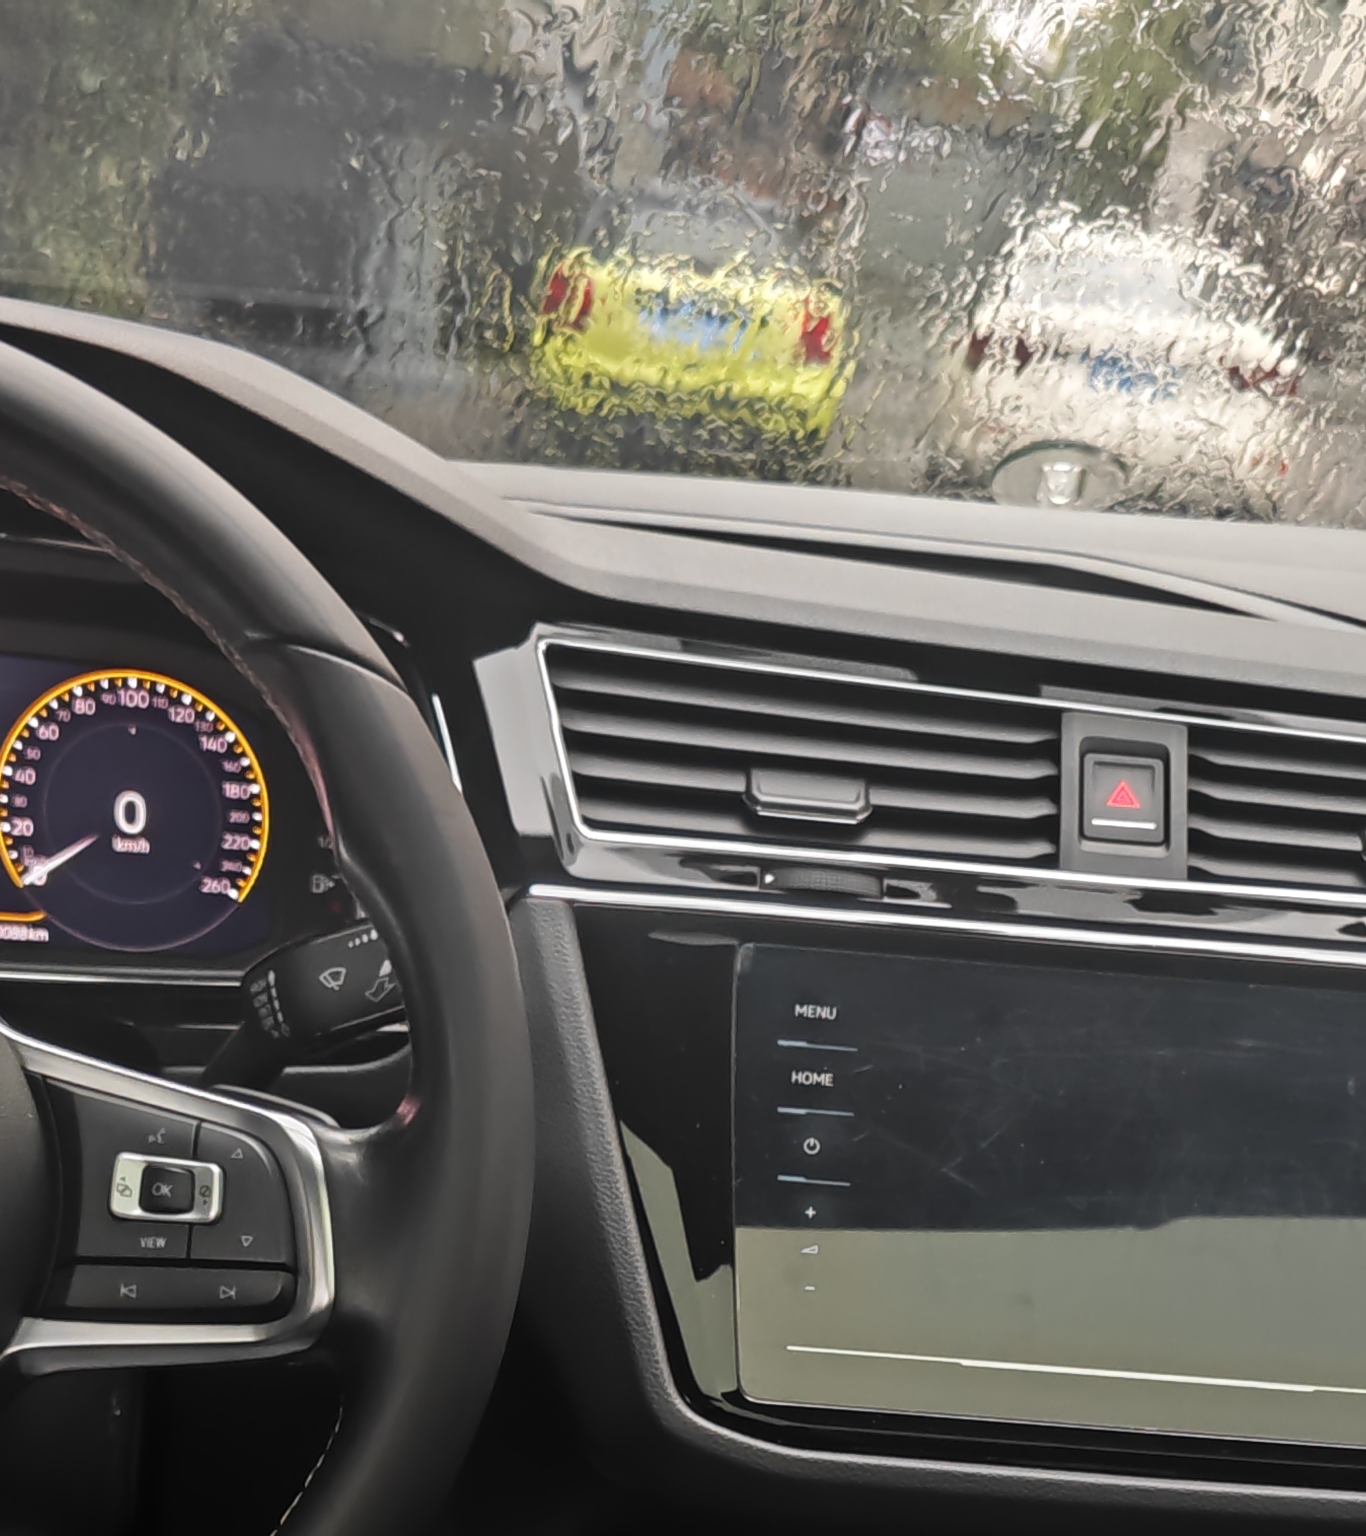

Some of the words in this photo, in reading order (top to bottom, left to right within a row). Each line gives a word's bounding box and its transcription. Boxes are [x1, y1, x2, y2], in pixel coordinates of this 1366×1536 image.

[72, 700, 96, 715] 80
[117, 690, 150, 708] 100
[169, 705, 195, 724] 120
[37, 725, 59, 741] 60
[200, 736, 228, 753] 140
[15, 768, 36, 785] 40
[222, 781, 250, 799] 180
[114, 790, 147, 834] 0
[11, 818, 34, 836] 20
[221, 833, 250, 850] 220
[200, 877, 231, 895] 260
[794, 1004, 837, 1020] MENU
[791, 1070, 834, 1087] HOME
[151, 1182, 174, 1198] OK
[140, 1236, 168, 1250] VIEW
